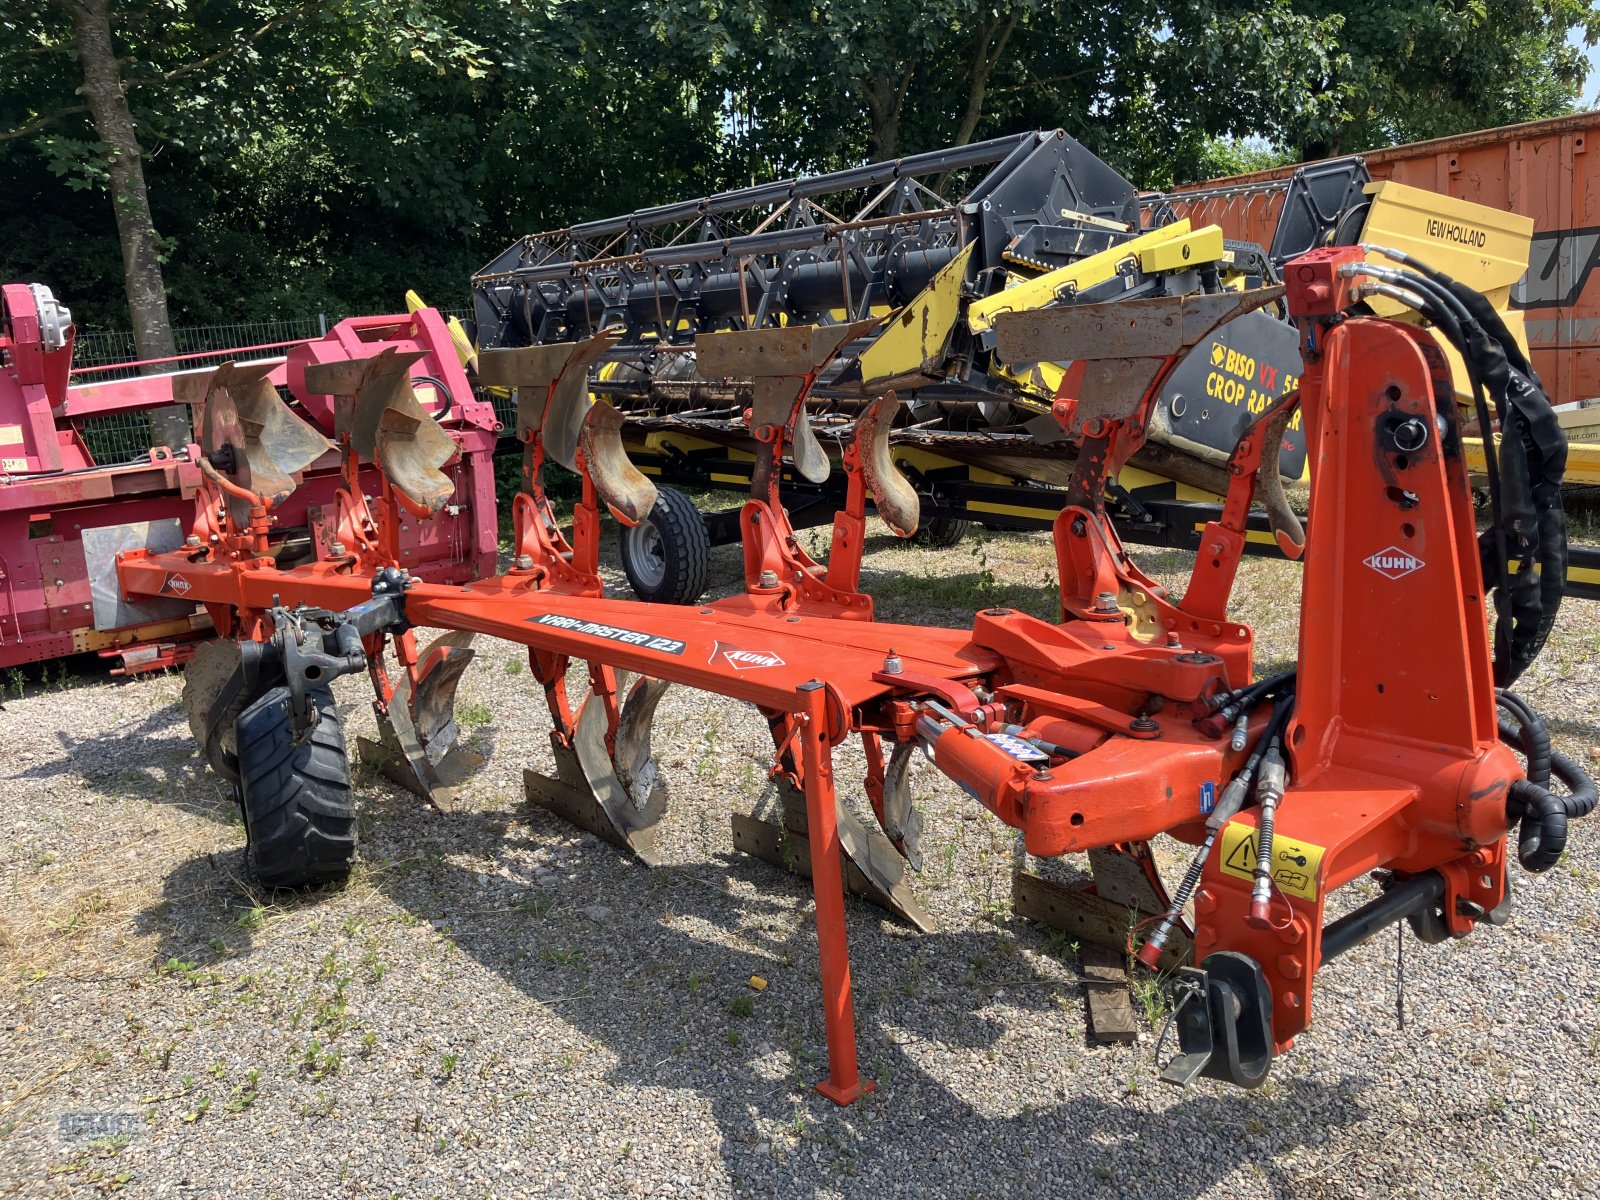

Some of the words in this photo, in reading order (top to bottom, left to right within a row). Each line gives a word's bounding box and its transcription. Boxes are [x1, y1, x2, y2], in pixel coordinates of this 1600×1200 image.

[1426, 219, 1447, 239] NEW
[1446, 223, 1486, 248] HOLLAND
[1225, 348, 1256, 381] BISO
[1259, 362, 1279, 393] VX
[1206, 371, 1246, 406] CROP
[1371, 555, 1417, 570] KUHN
[538, 614, 646, 645] VARI-MASTER
[644, 636, 684, 653] 123
[729, 650, 779, 667] KUHN
